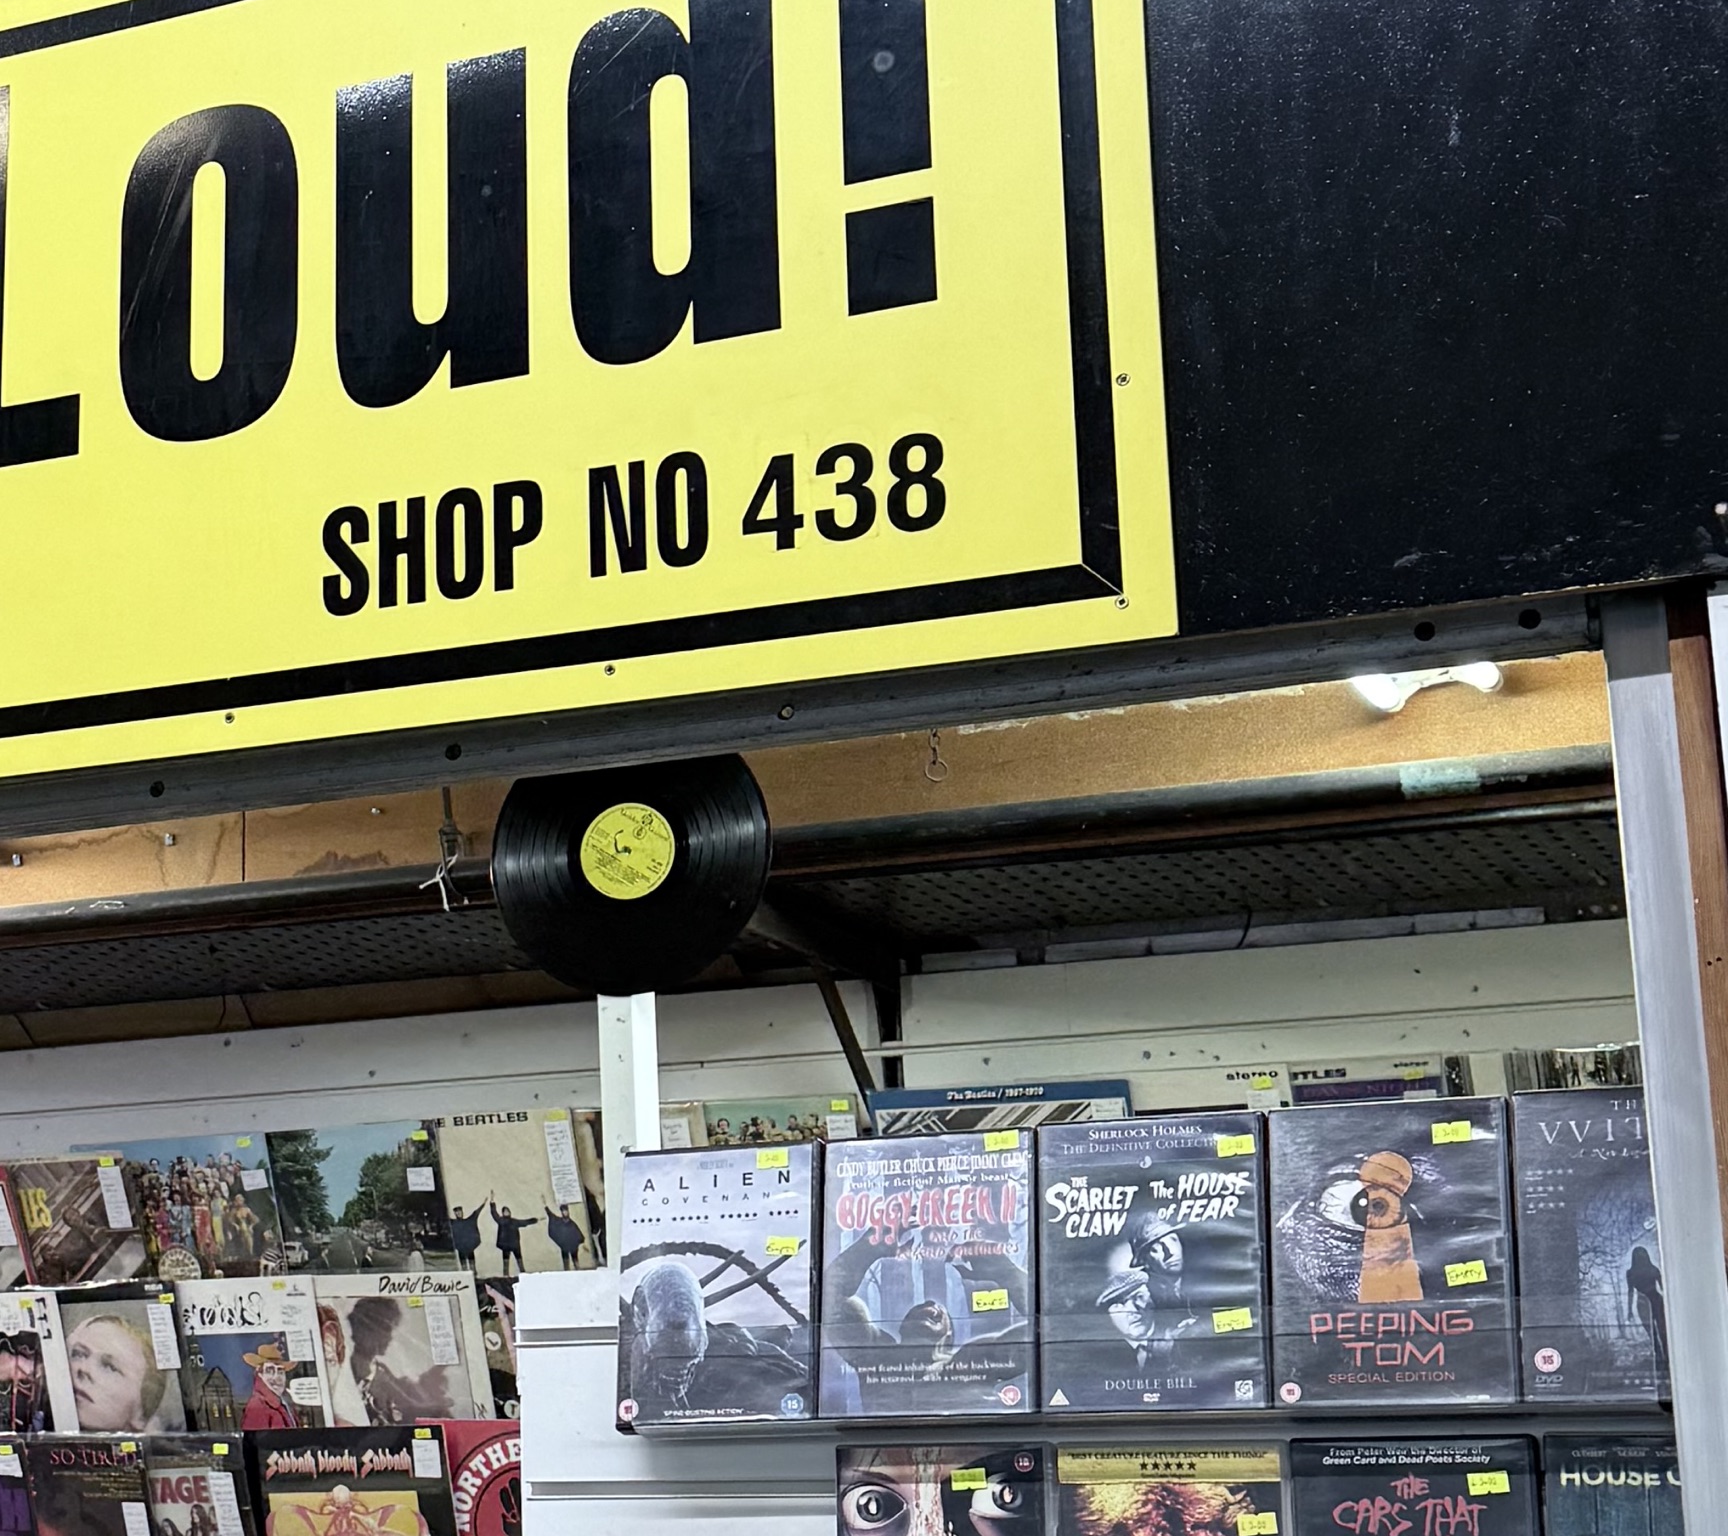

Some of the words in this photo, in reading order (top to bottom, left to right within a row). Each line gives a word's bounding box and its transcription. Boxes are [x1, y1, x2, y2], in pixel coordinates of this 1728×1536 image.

[321, 479, 544, 617] SHOP
[589, 459, 710, 576] NO
[740, 433, 948, 554] 438
[452, 1112, 529, 1128] BEATLES
[1089, 1128, 1148, 1140] SHERLOCK
[1153, 1125, 1202, 1138] HOLMES
[643, 1169, 791, 1193] ALIEN
[1071, 1176, 1088, 1188] THE
[1150, 1180, 1174, 1199] The
[1177, 1172, 1252, 1198] HOUSE
[1045, 1183, 1138, 1222] SCARLET
[1178, 1196, 1240, 1222] FEAR
[1066, 1212, 1127, 1238] CLAW
[379, 1275, 422, 1293] David
[422, 1276, 469, 1292] Bowie
[1310, 1310, 1473, 1344] PEEPING
[1342, 1342, 1445, 1366] TOM
[1105, 1379, 1161, 1390] DOUBLE
[1167, 1378, 1197, 1389] BILL
[1328, 1372, 1390, 1384] SPECIAL
[1395, 1370, 1455, 1383] EDITION
[1391, 1472, 1430, 1500] THE
[1560, 1463, 1662, 1487] HOUSE
[1415, 1495, 1488, 1536] THAT
